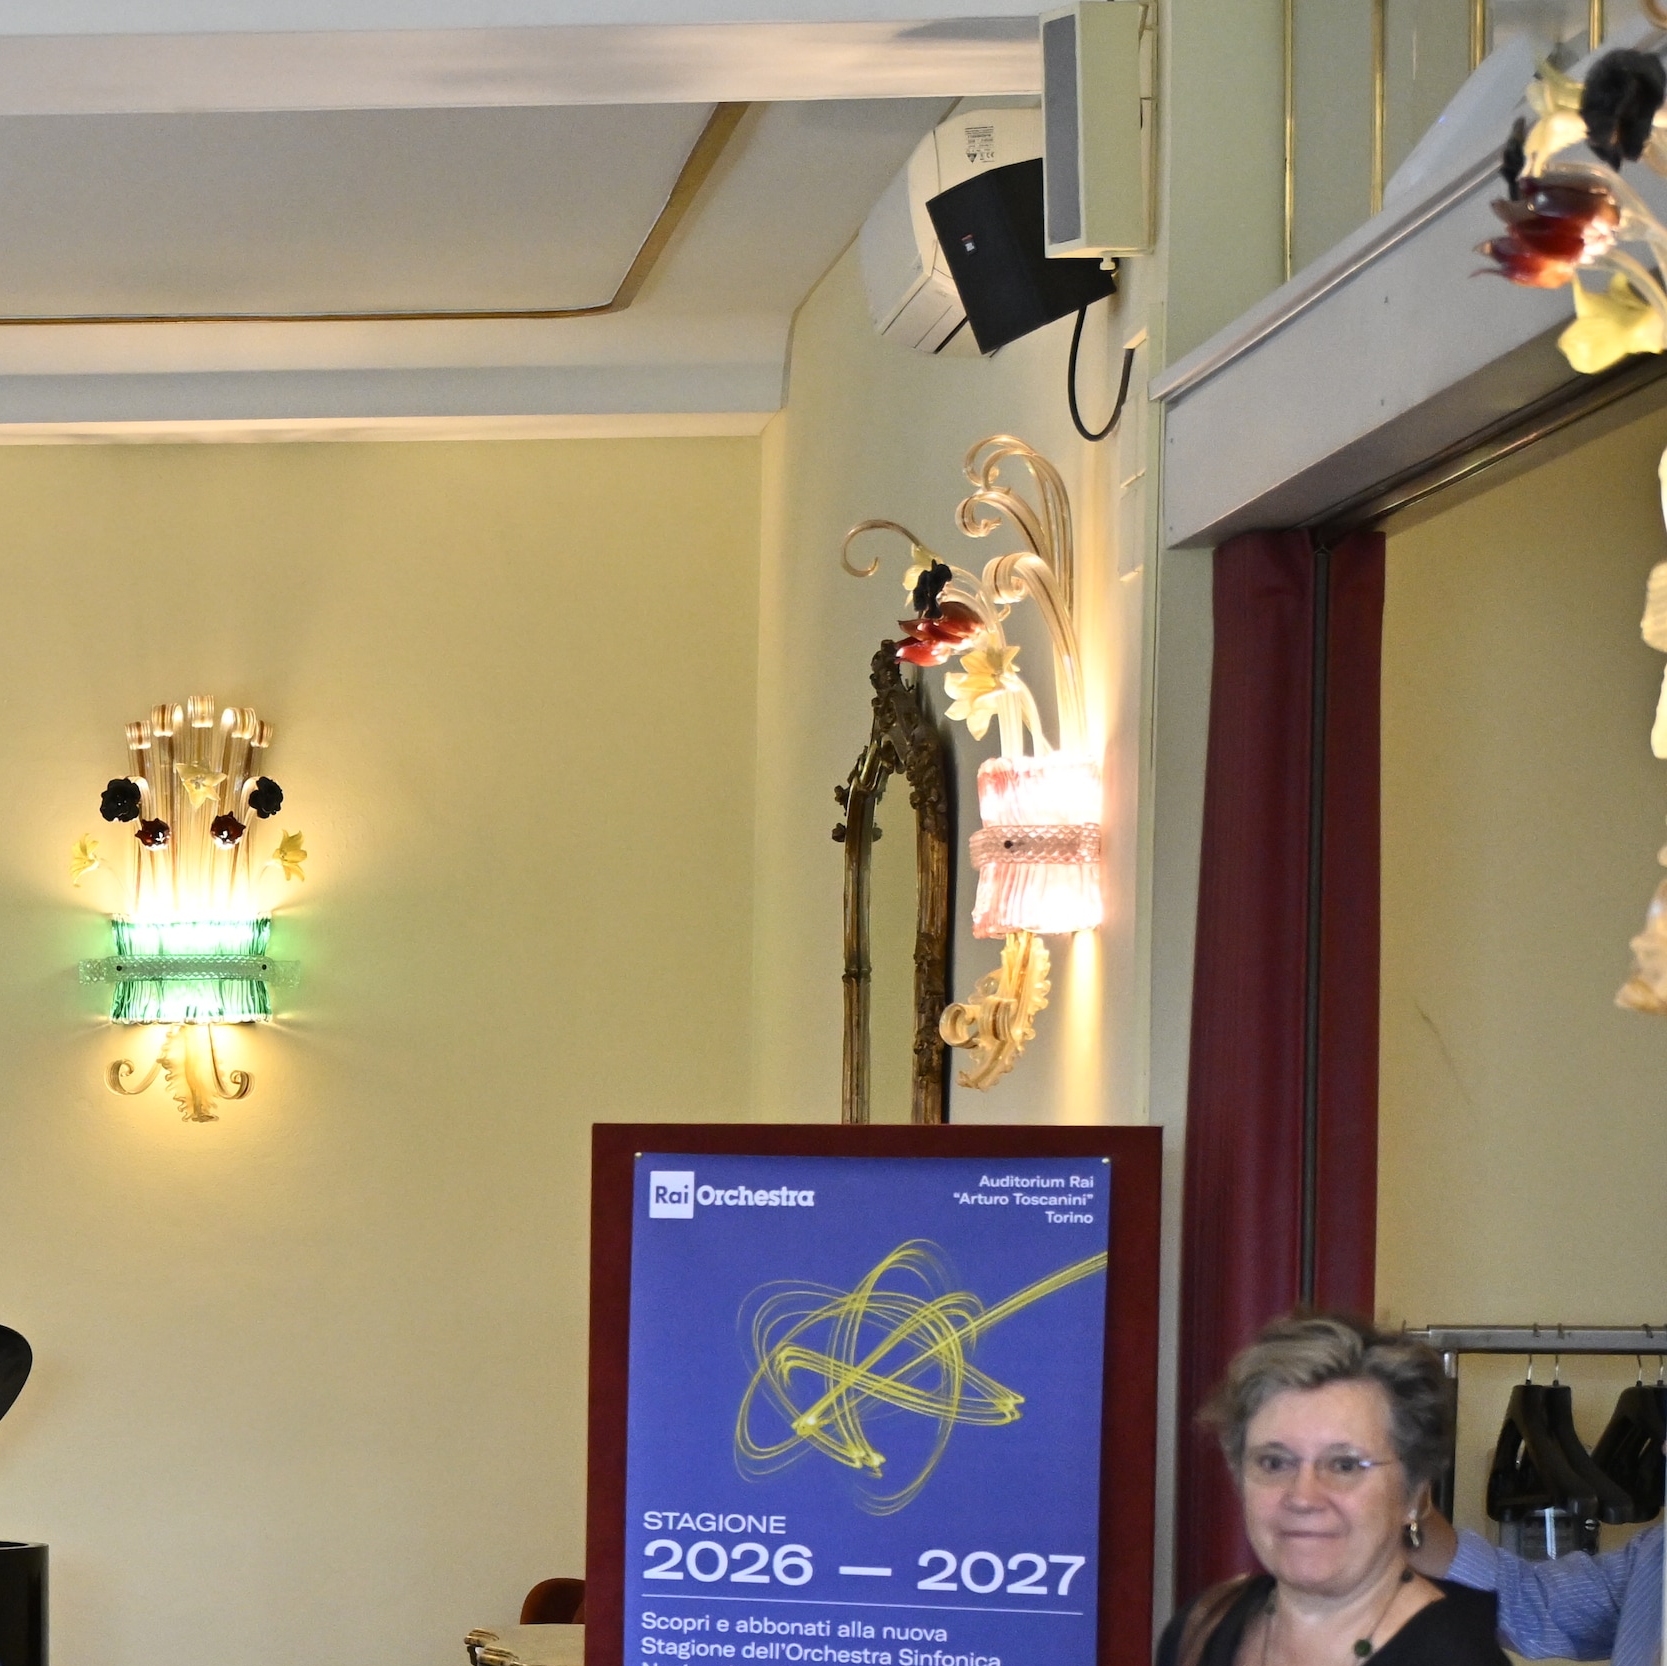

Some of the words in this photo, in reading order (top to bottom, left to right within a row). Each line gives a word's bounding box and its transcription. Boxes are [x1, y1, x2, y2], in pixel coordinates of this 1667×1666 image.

[978, 1175, 1065, 1188] Auditorium
[1069, 1175, 1094, 1188] Rai
[655, 1184, 689, 1205] Rai
[696, 1185, 816, 1207] Orchestra
[1045, 1211, 1094, 1224] Torino
[643, 1511, 787, 1535] STAGIONE
[643, 1538, 814, 1586] 2026
[917, 1549, 1086, 1596] 2027
[641, 1611, 710, 1635] Scopri
[716, 1619, 730, 1633] e
[735, 1616, 831, 1637] abbonati
[837, 1621, 875, 1639] alla
[882, 1626, 948, 1643] nuova
[641, 1637, 736, 1660] Stagione
